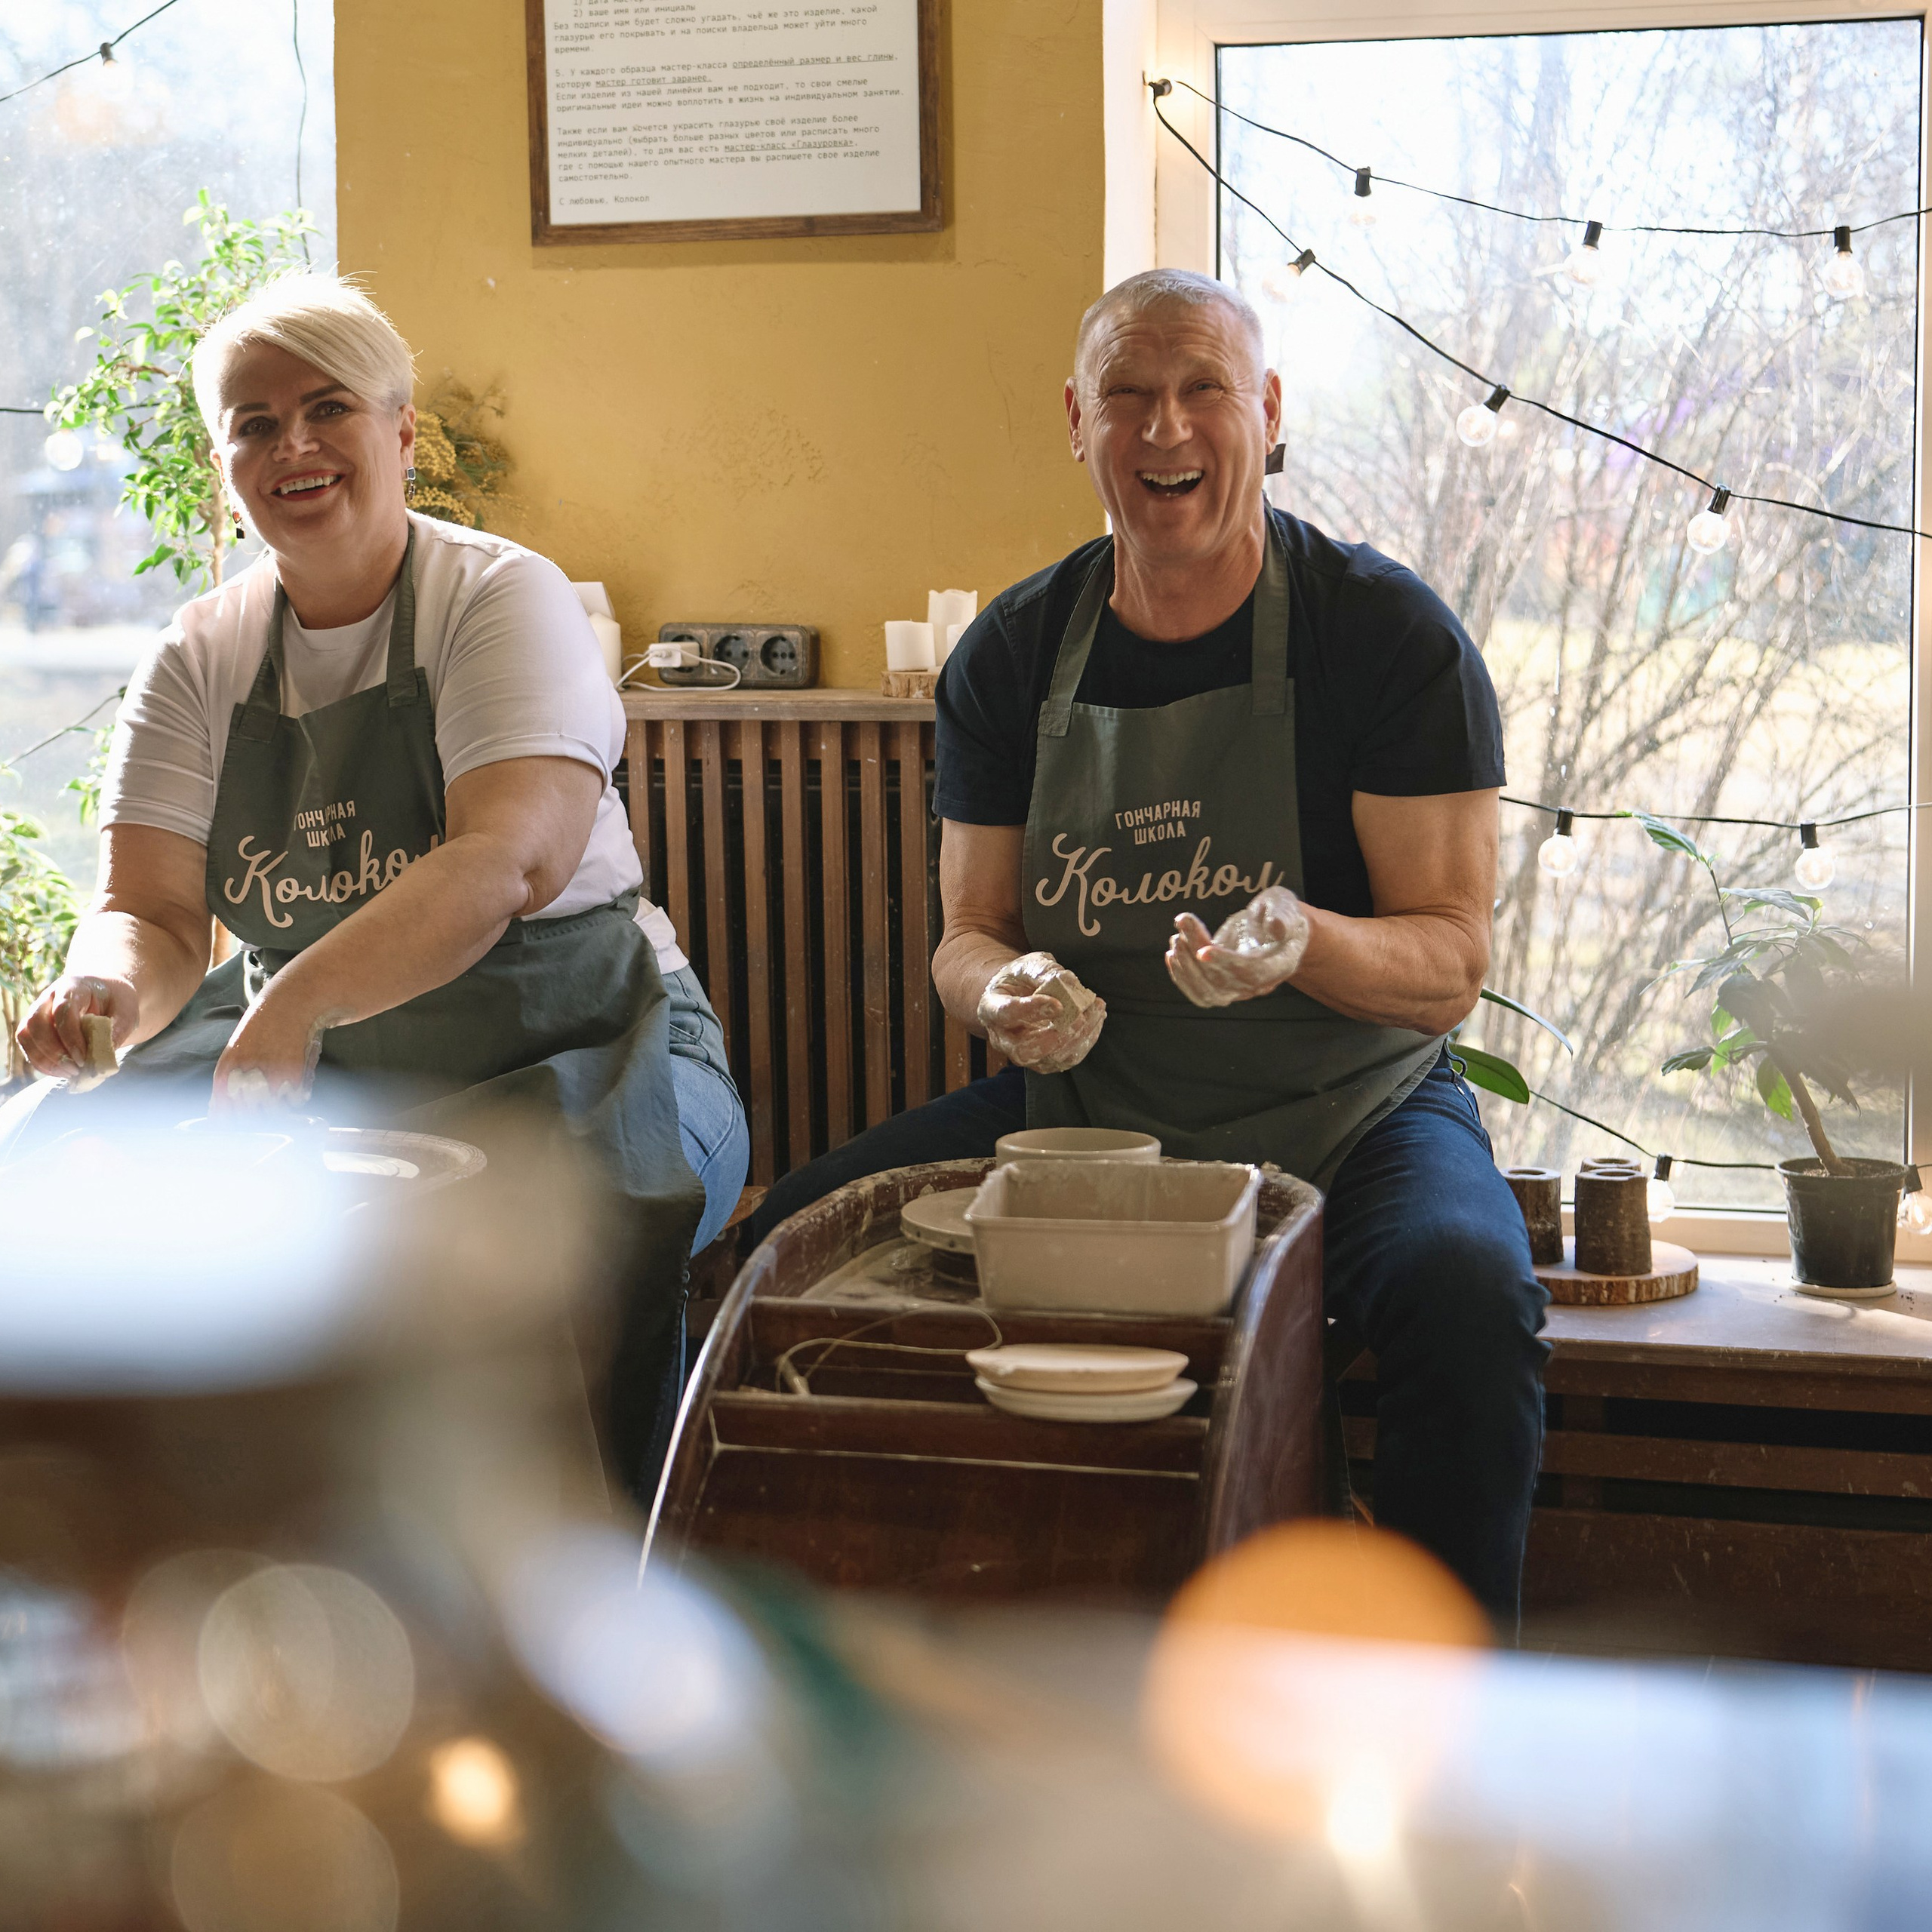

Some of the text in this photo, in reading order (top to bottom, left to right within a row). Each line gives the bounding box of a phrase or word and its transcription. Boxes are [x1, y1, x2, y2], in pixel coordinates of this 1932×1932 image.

[554, 20, 569, 29] Без
[574, 20, 610, 29] подписи
[634, 16, 660, 27] будет
[664, 15, 696, 23] сложно
[851, 5, 877, 14] какой
[574, 8, 583, 18] 2)
[654, 5, 695, 14] инициалы
[554, 32, 595, 42] глазурью
[619, 28, 666, 39] покрывать
[696, 25, 728, 33] поиски
[732, 23, 779, 33] владельца
[783, 21, 809, 29] может
[815, 18, 836, 29] уйти
[841, 18, 866, 26] много
[555, 45, 594, 54] времени.
[571, 67, 575, 76] У
[580, 67, 616, 76] каждого
[620, 63, 657, 75] образца
[661, 61, 728, 73] мастер-класса
[732, 57, 795, 70] определённый
[798, 57, 832, 66] размер
[555, 76, 712, 90] которую мастер готовит заранее.
[555, 91, 577, 100] Если
[581, 91, 616, 100] изделие
[635, 87, 661, 96] нашей
[667, 85, 702, 94] линейки
[836, 78, 868, 86] смелые
[557, 101, 617, 112] оригинальные
[622, 100, 641, 109] идеи
[676, 97, 723, 106] воплотить
[738, 94, 764, 103] жизнь
[785, 91, 859, 102] индивидуальном
[557, 125, 583, 134] Также
[673, 121, 714, 131] украсить
[718, 119, 761, 129] глазурью
[790, 116, 828, 125] изделие
[832, 113, 859, 122] более
[557, 137, 623, 148] индивидуально
[673, 132, 703, 141] больше
[708, 132, 740, 142] разных
[744, 131, 776, 140] цветов
[801, 128, 848, 138] расписать
[853, 126, 880, 134] много
[557, 150, 587, 158] мелких
[658, 146, 673, 155] для
[724, 142, 786, 153] мастер-класс
[558, 162, 574, 171] где
[589, 160, 623, 170] помощью
[708, 155, 746, 165] мастера
[765, 152, 812, 163] распишете
[842, 149, 880, 159] изделие
[558, 172, 632, 182] самостоятельно.
[559, 196, 565, 205] С
[614, 194, 651, 203] Колокол
[294, 800, 355, 831] ОНЧРНАЯ
[1115, 800, 1201, 829] ГОНЧАРНАЯ
[306, 823, 346, 847] ШКЛА
[1134, 820, 1186, 845] ШКОЛА
